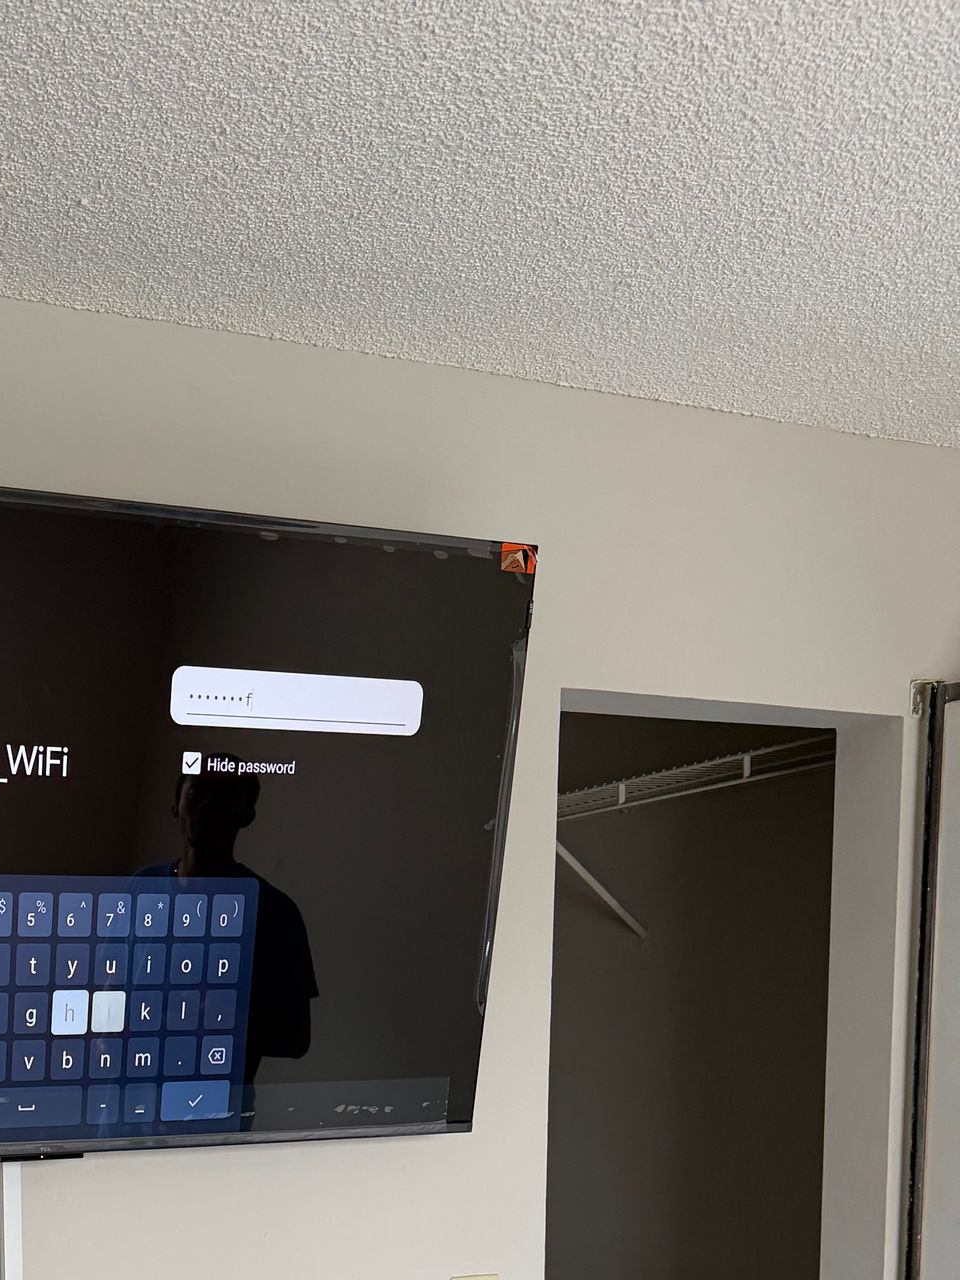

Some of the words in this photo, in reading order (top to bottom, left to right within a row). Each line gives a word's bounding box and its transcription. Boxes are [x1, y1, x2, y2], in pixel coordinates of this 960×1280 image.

[207, 758, 236, 773] Hide
[238, 760, 296, 776] password
[27, 913, 35, 927] 5
[66, 913, 75, 927] 6
[106, 913, 114, 927] 7
[144, 913, 152, 927] 8
[182, 913, 190, 927] 9
[220, 913, 227, 927] 0
[29, 957, 37, 974] t
[67, 960, 78, 979] y
[106, 959, 116, 974] u
[147, 955, 151, 973] i
[181, 959, 191, 973] o
[218, 959, 229, 977] p
[26, 1008, 37, 1027] g
[64, 1003, 75, 1022] h
[141, 1002, 150, 1020] k
[23, 1056, 35, 1070] v
[62, 1050, 73, 1069] b
[100, 1053, 111, 1068] n
[135, 1052, 151, 1067] m
